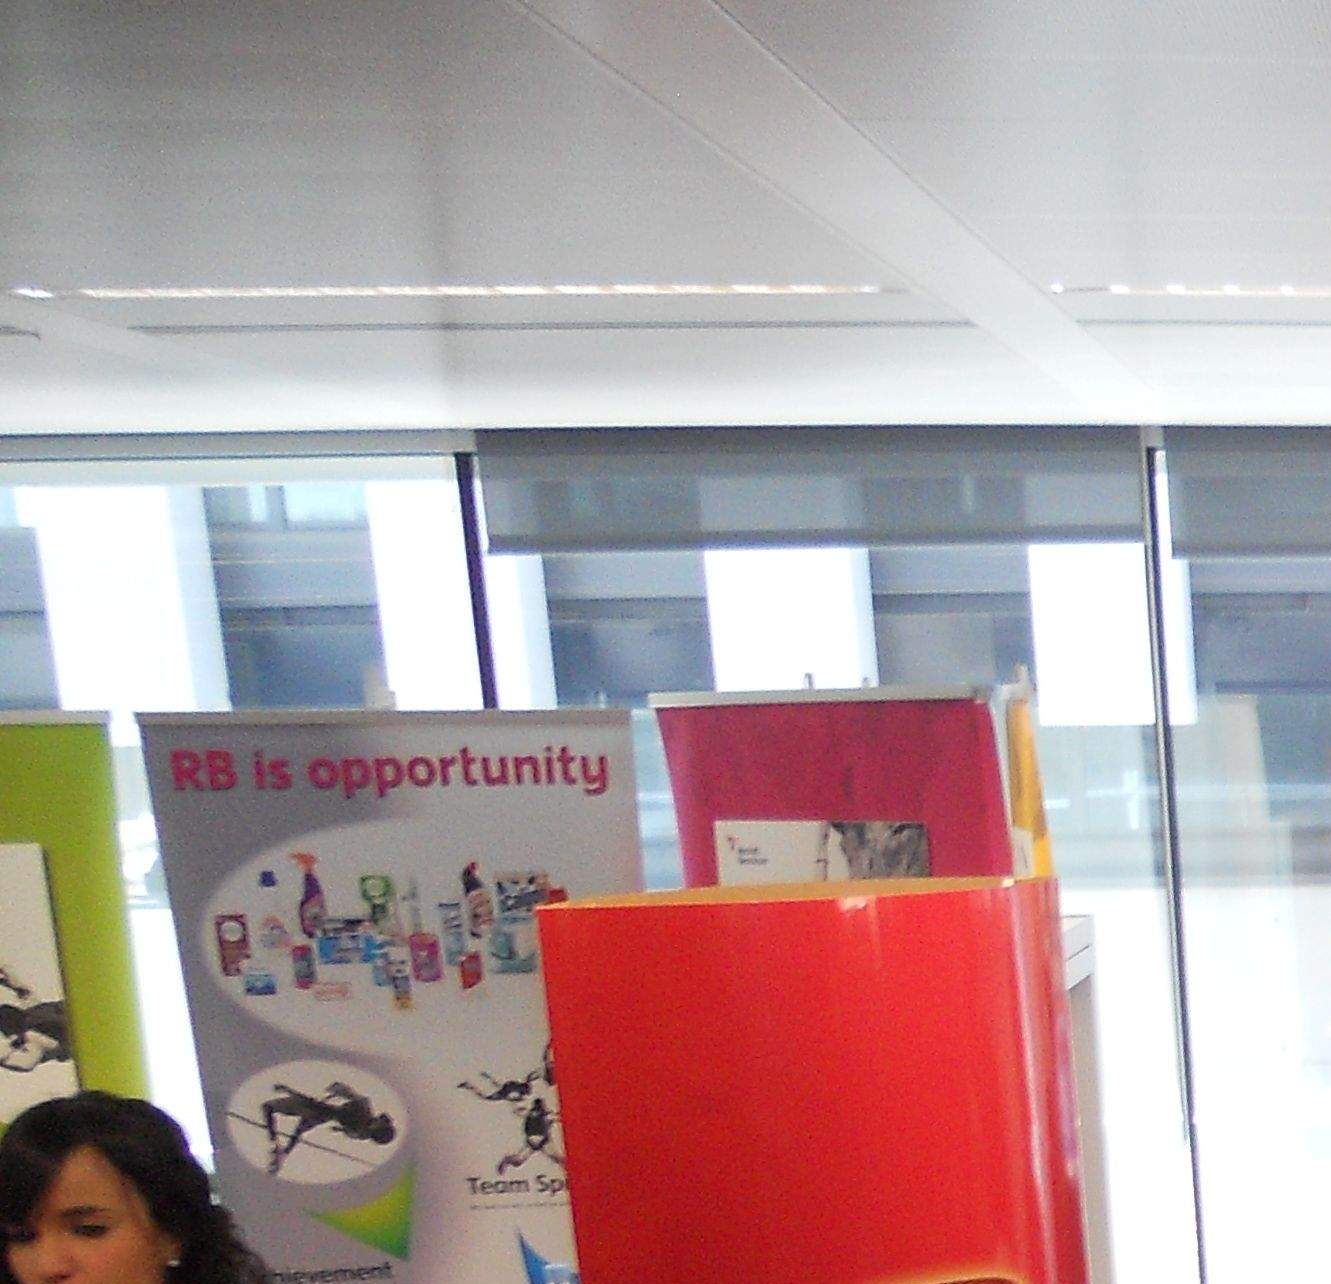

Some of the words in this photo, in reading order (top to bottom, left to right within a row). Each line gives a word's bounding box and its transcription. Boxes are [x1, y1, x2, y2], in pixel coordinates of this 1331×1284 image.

[171, 747, 237, 791] RB
[254, 748, 292, 789] is
[308, 744, 609, 798] opportunity
[466, 1176, 529, 1195] Team
[536, 1172, 568, 1194] Sp
